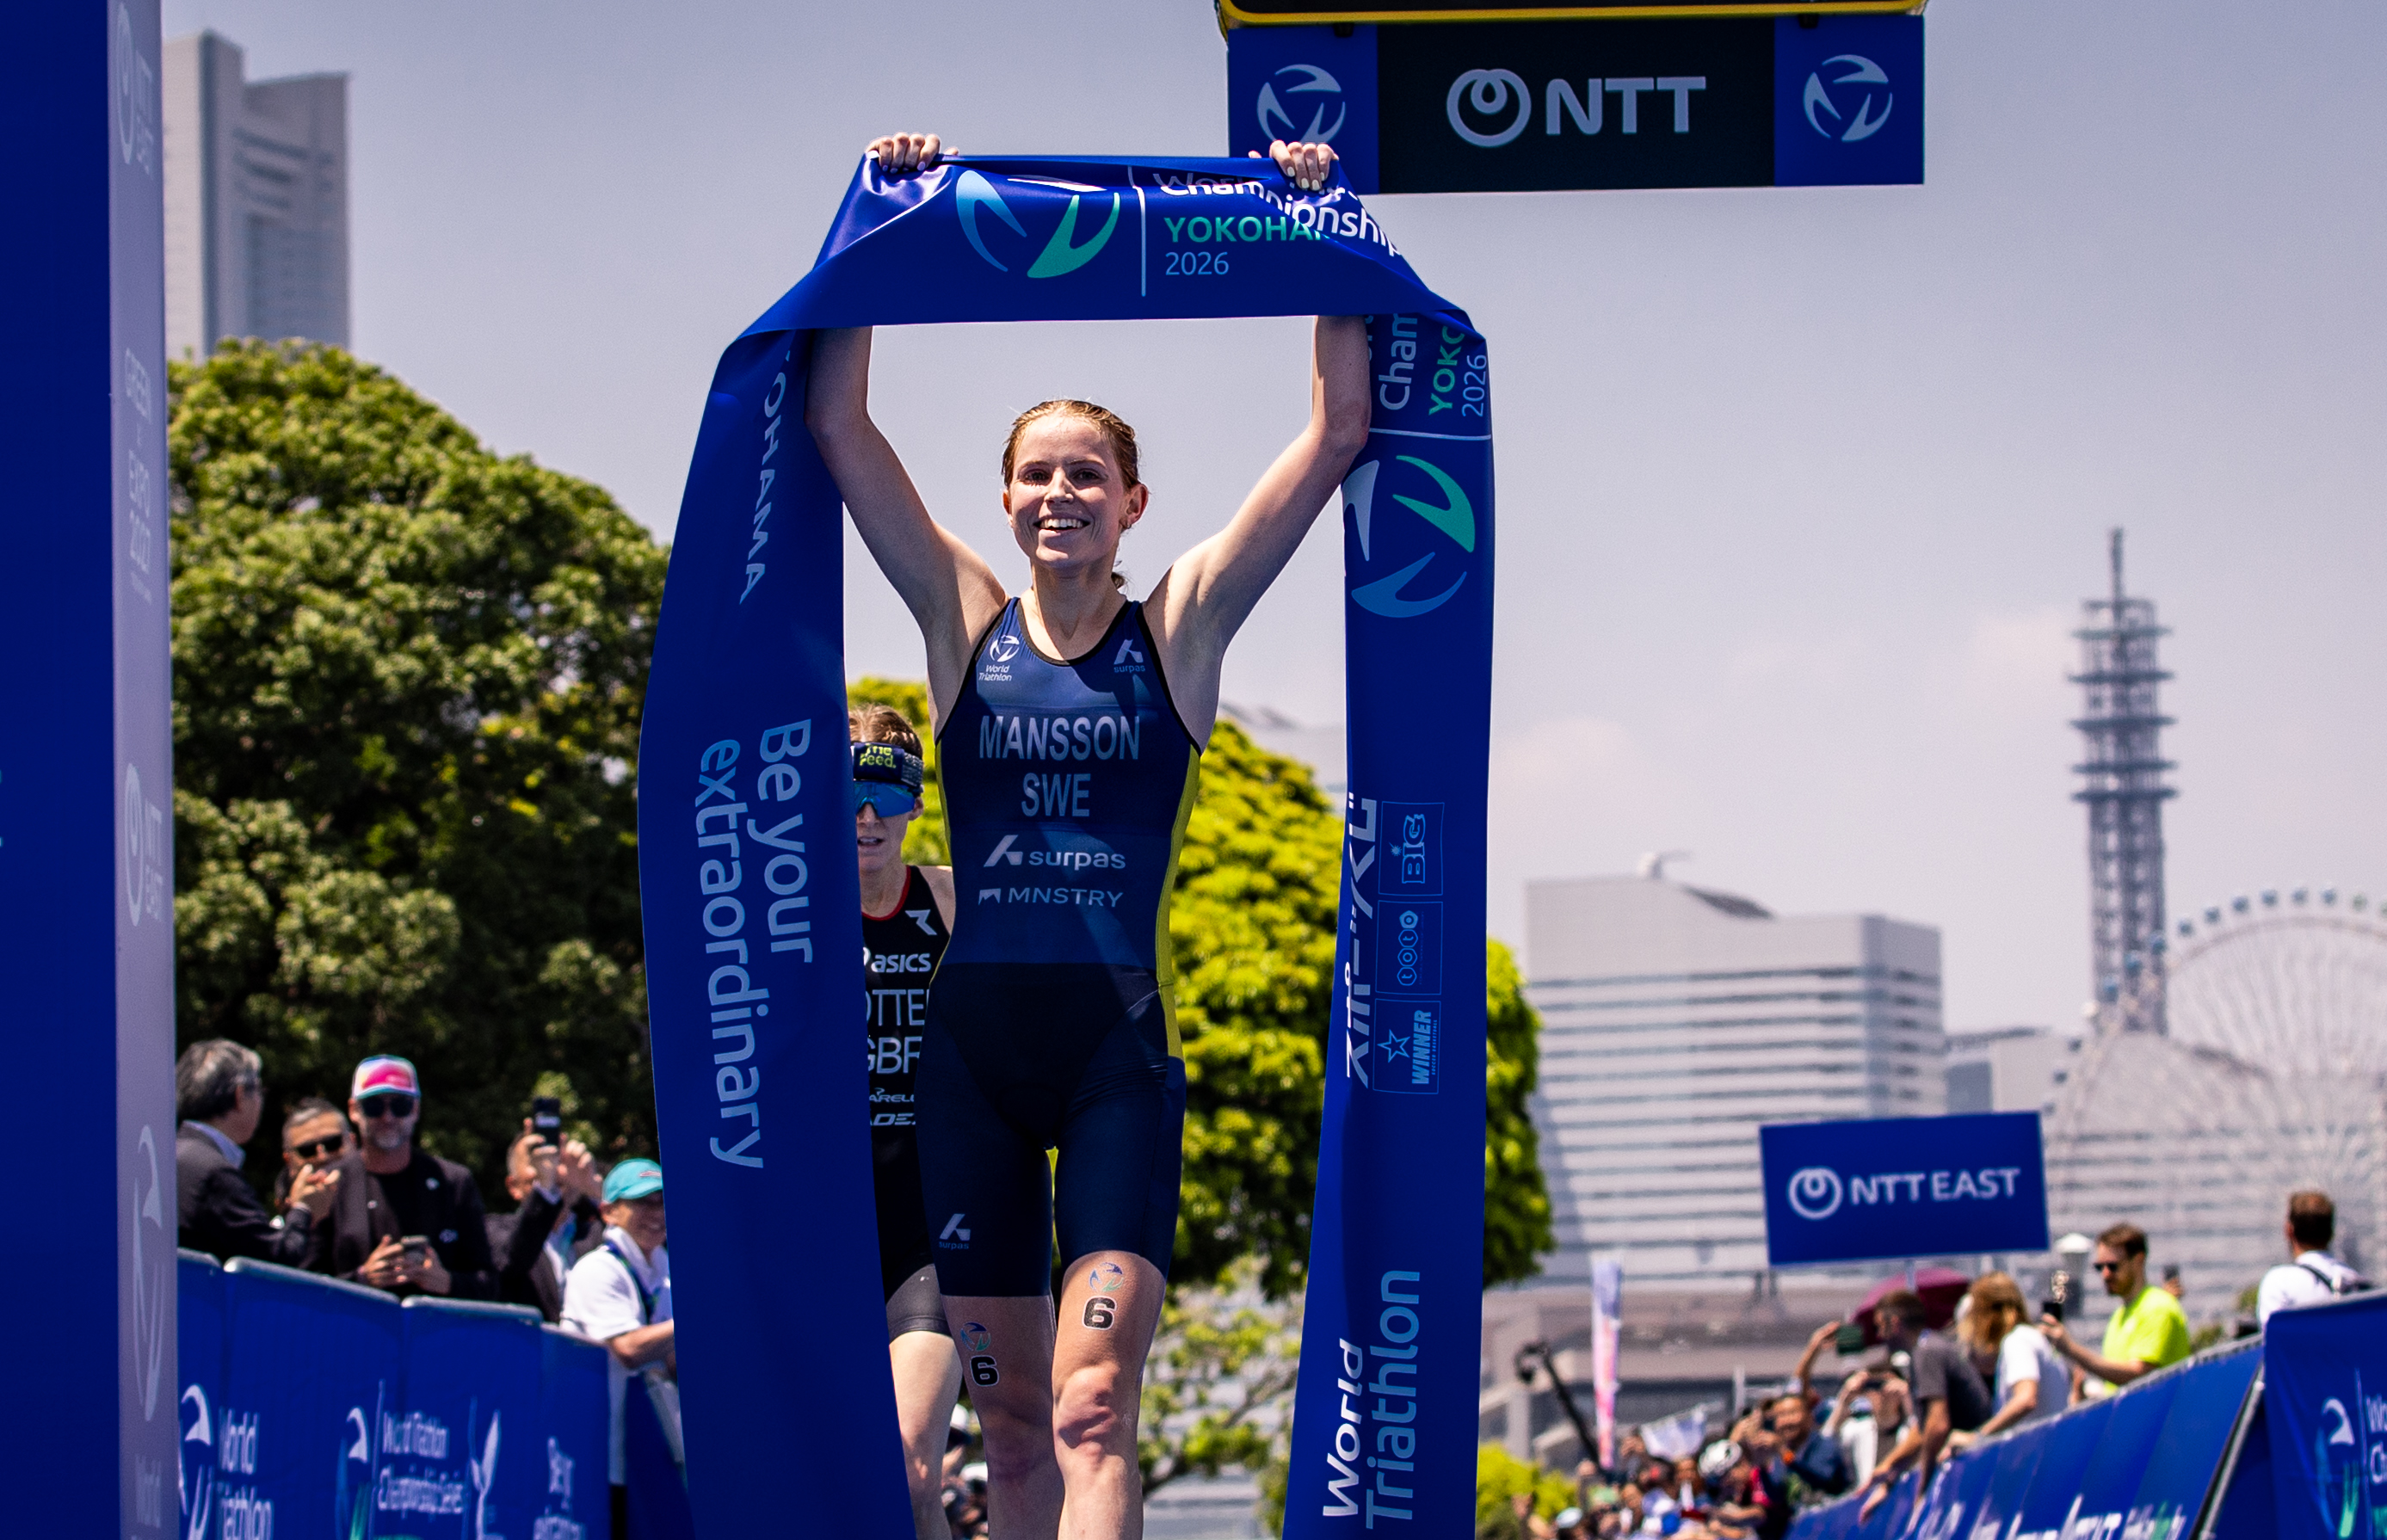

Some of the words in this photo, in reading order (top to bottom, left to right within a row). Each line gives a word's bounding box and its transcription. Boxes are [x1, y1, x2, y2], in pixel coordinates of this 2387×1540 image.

[1546, 76, 1706, 136] NTT
[1165, 251, 1230, 276] 2026
[1461, 354, 1488, 417] 2026
[738, 350, 791, 605] OHAMA
[978, 672, 1012, 681] Triathlon
[985, 664, 1010, 673] World
[1113, 665, 1145, 674] surpas
[757, 718, 812, 802] Be
[978, 716, 1140, 761] MANSSON
[1021, 773, 1091, 817] SWE
[1027, 849, 1126, 871] surpas
[1401, 814, 1426, 884] BIG
[747, 813, 813, 964] your
[1008, 887, 1124, 909] MNSTRY
[695, 738, 770, 1169] extraordinary
[866, 989, 930, 1027] TTE
[1411, 1009, 1432, 1085] WINNER
[1851, 1173, 1926, 1206] NTT
[1930, 1166, 2021, 1202] EAST
[939, 1241, 970, 1251] surpas
[1082, 1295, 1118, 1331] 6
[970, 1355, 1000, 1387] 6
[1366, 1270, 1421, 1530] Triathlon
[1323, 1338, 1363, 1517] World
